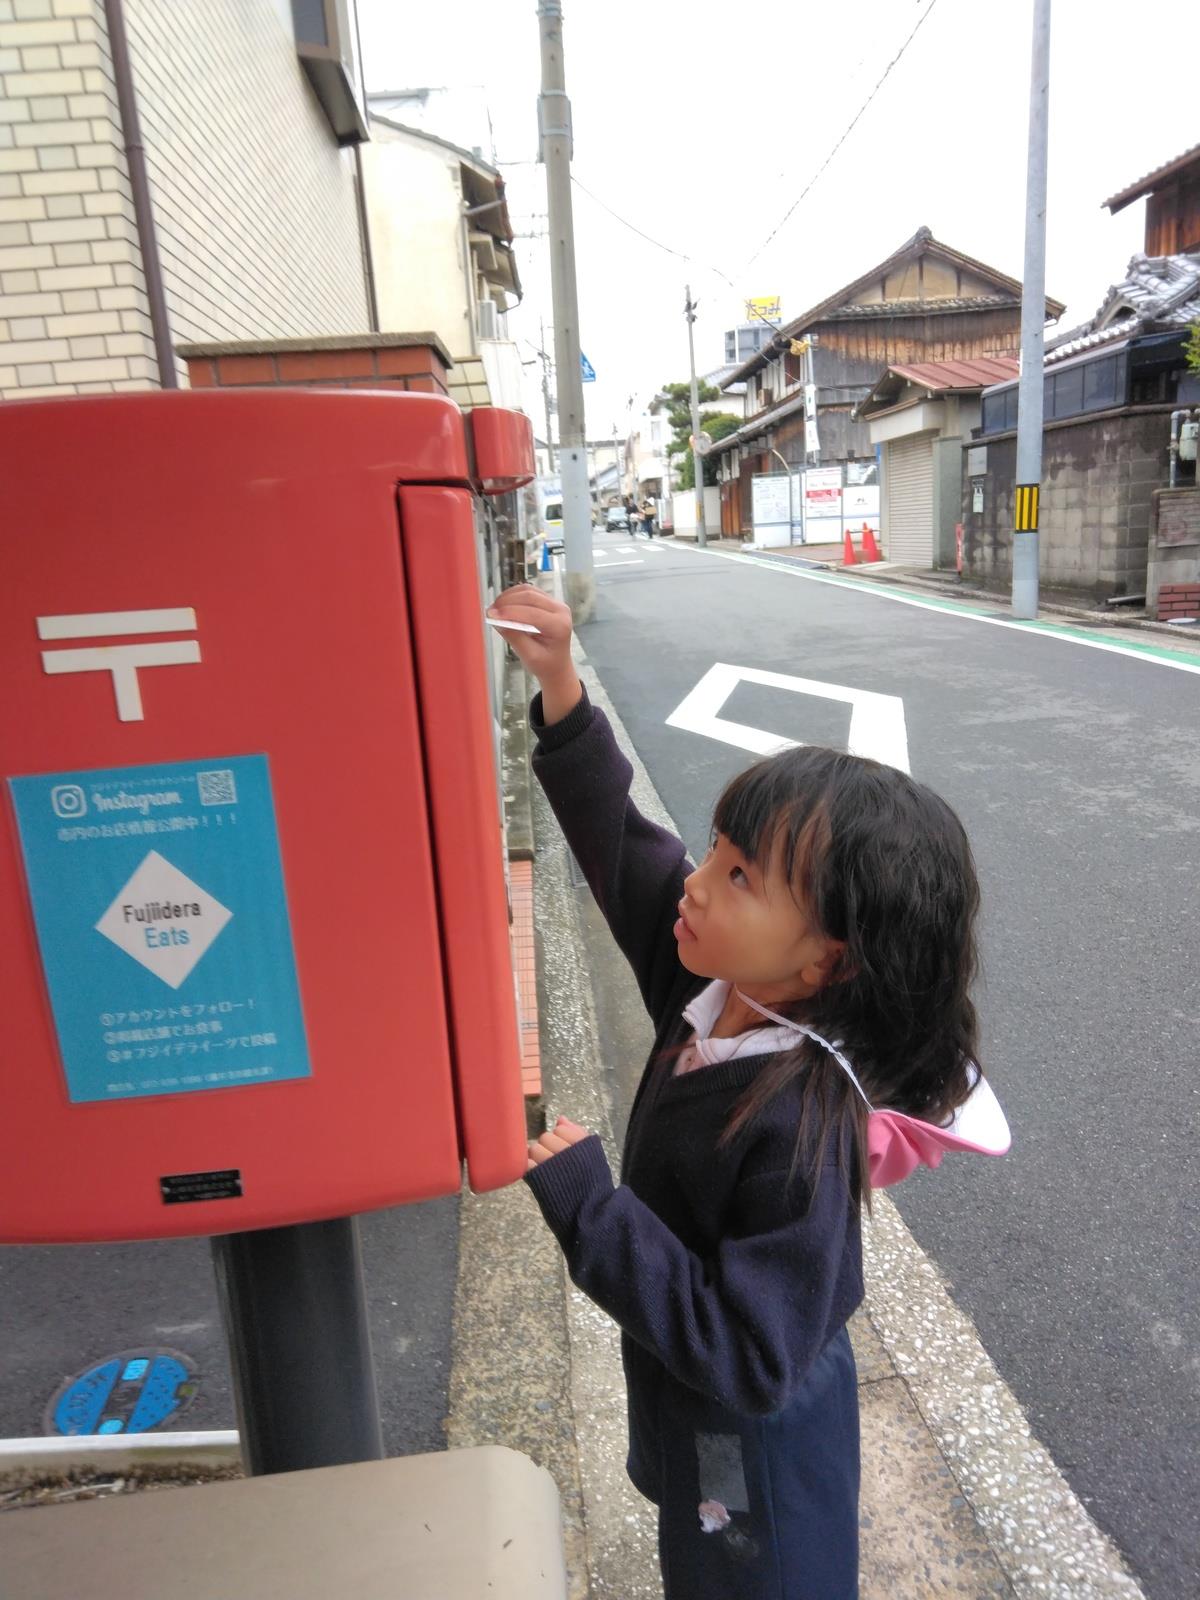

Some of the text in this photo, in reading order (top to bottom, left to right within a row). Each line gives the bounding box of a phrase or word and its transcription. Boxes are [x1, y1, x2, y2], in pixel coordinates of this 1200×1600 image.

[92, 789, 183, 815] Instagram
[123, 900, 202, 924] Fujiidera
[145, 926, 191, 949] Eats
